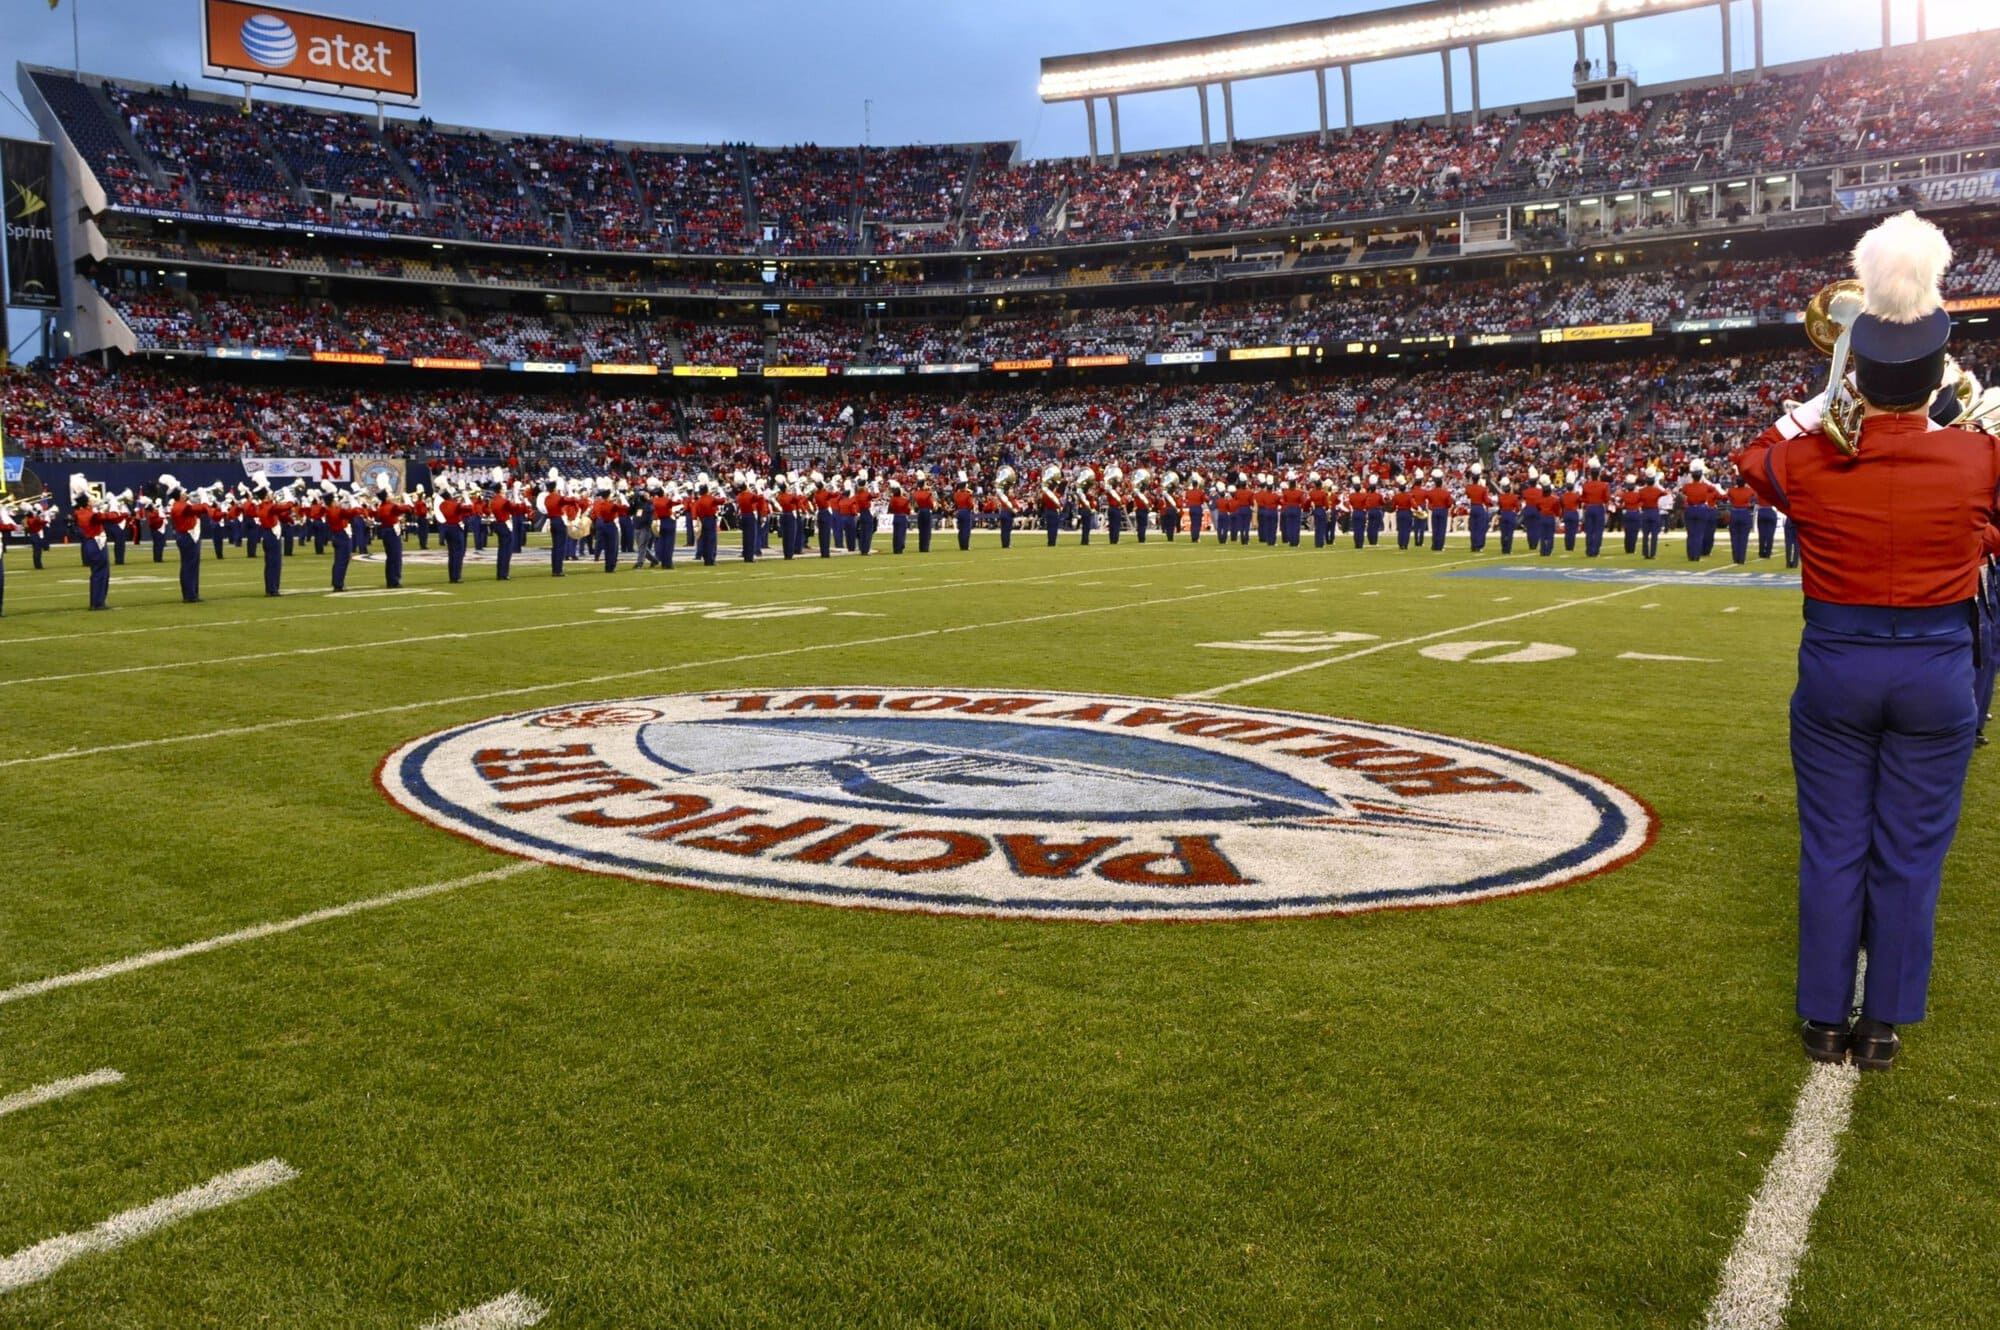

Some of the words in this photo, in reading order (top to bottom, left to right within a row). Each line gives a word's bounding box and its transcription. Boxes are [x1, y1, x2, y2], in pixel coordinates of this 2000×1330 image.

[307, 34, 392, 77] at&t
[7, 223, 53, 241] Sprint
[313, 352, 350, 362] WELLS
[351, 353, 385, 364] FARGO
[994, 361, 1022, 370] WELLS
[1023, 359, 1052, 369] FARGO
[320, 461, 342, 480] N
[704, 691, 1053, 720] BOWL
[1028, 701, 1539, 797] HOLIDAY
[471, 743, 661, 814] LIFE
[560, 793, 1262, 887] PACIFIC
